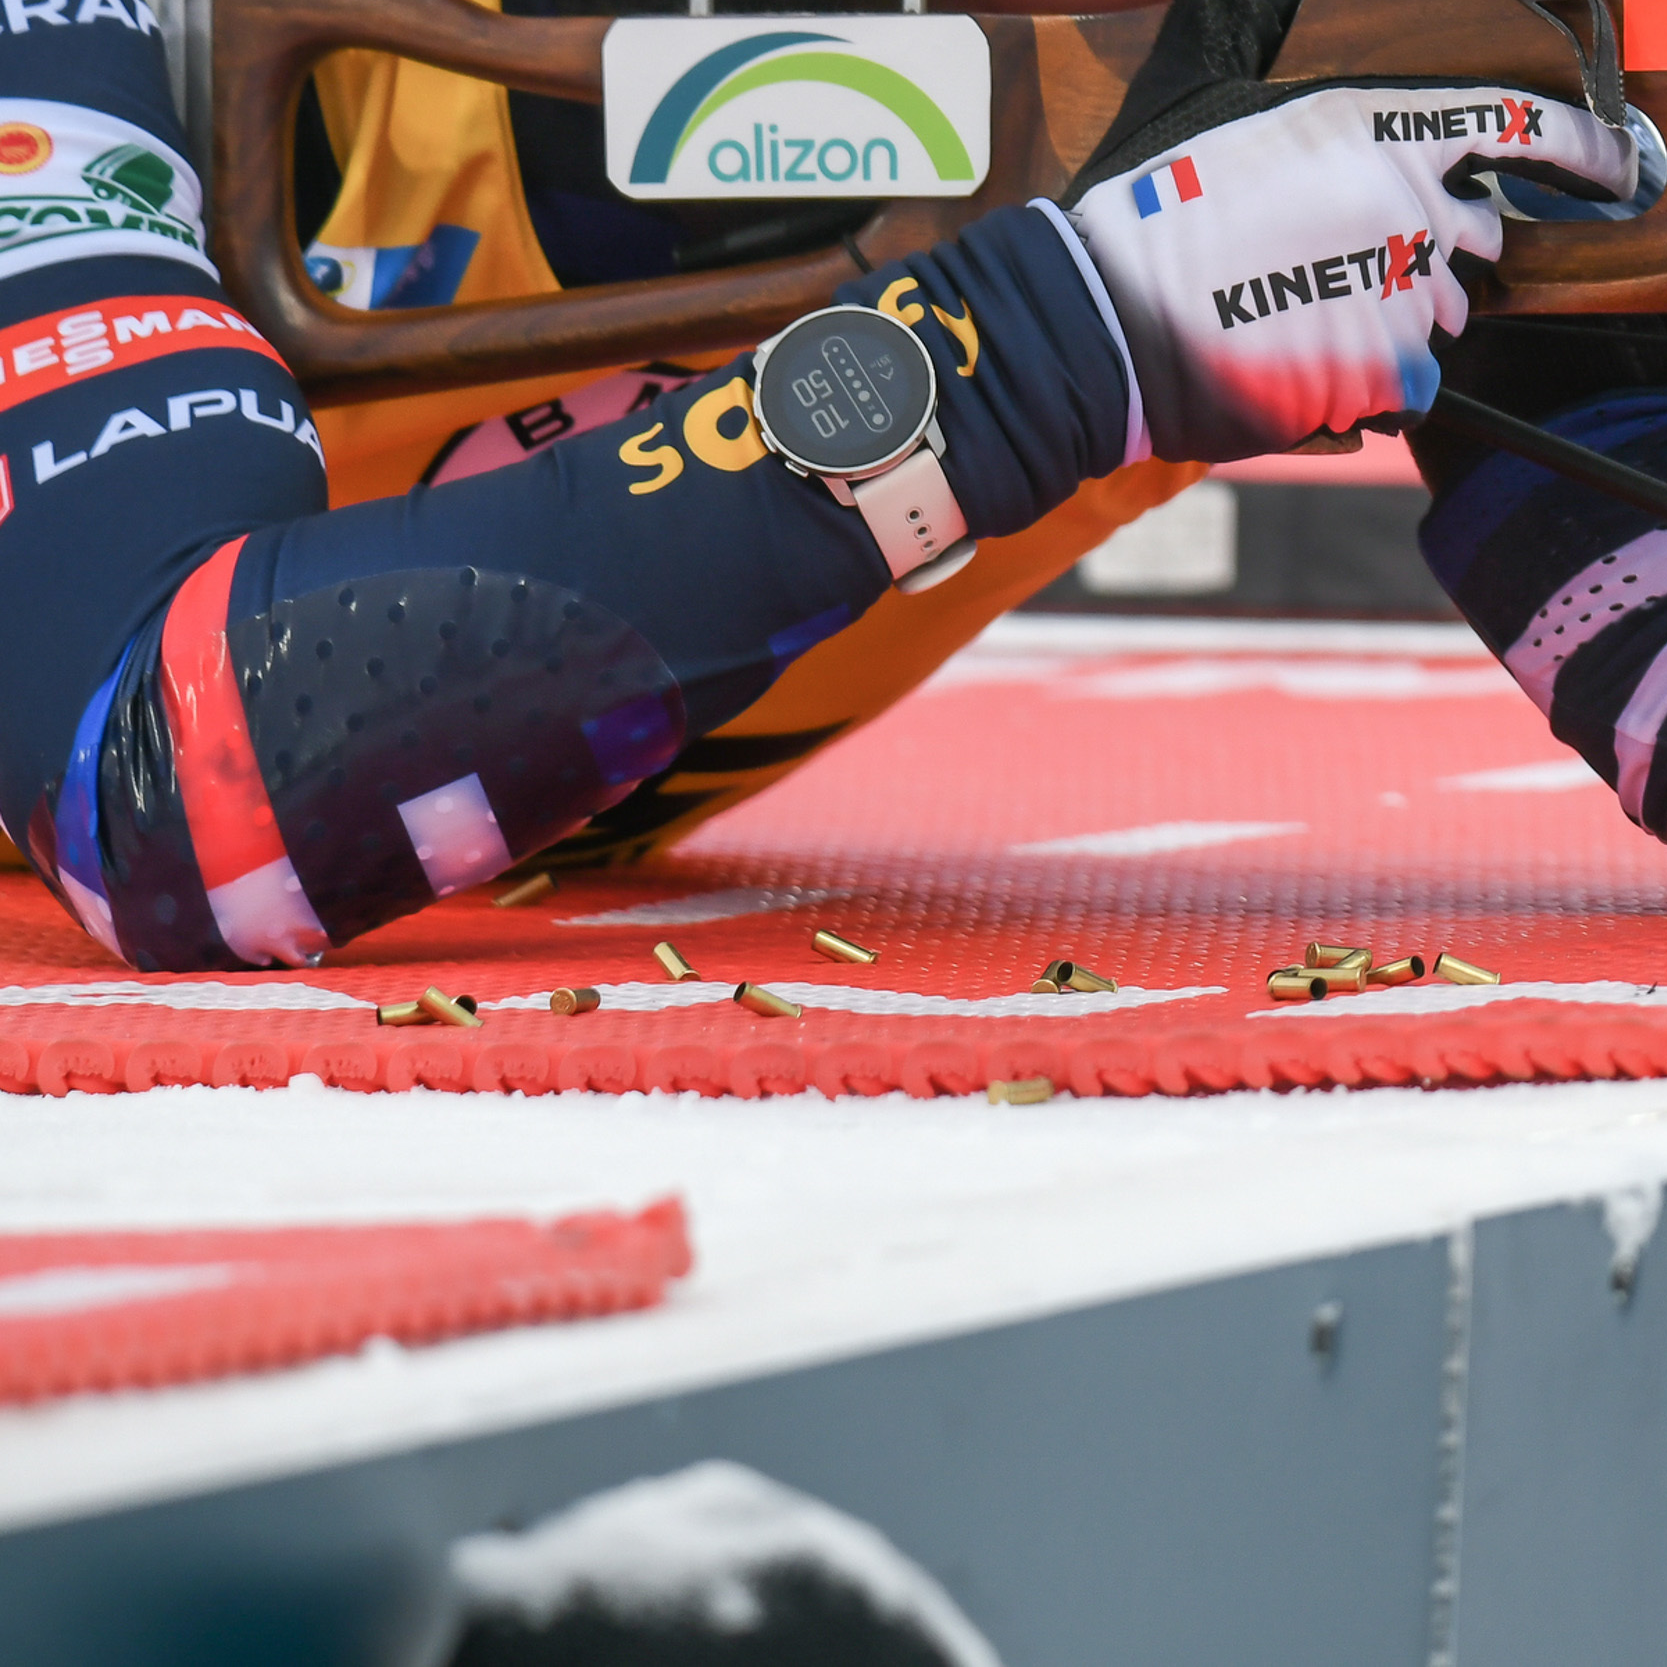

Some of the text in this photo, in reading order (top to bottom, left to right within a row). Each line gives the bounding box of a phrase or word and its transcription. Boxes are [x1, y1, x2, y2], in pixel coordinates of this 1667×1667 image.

[1373, 97, 1543, 145] KINETIXX
[708, 122, 898, 183] alizon
[1213, 229, 1436, 329] KINETIXX
[791, 369, 834, 408] 50
[31, 387, 326, 485] LAPUA
[811, 403, 850, 439] 10
